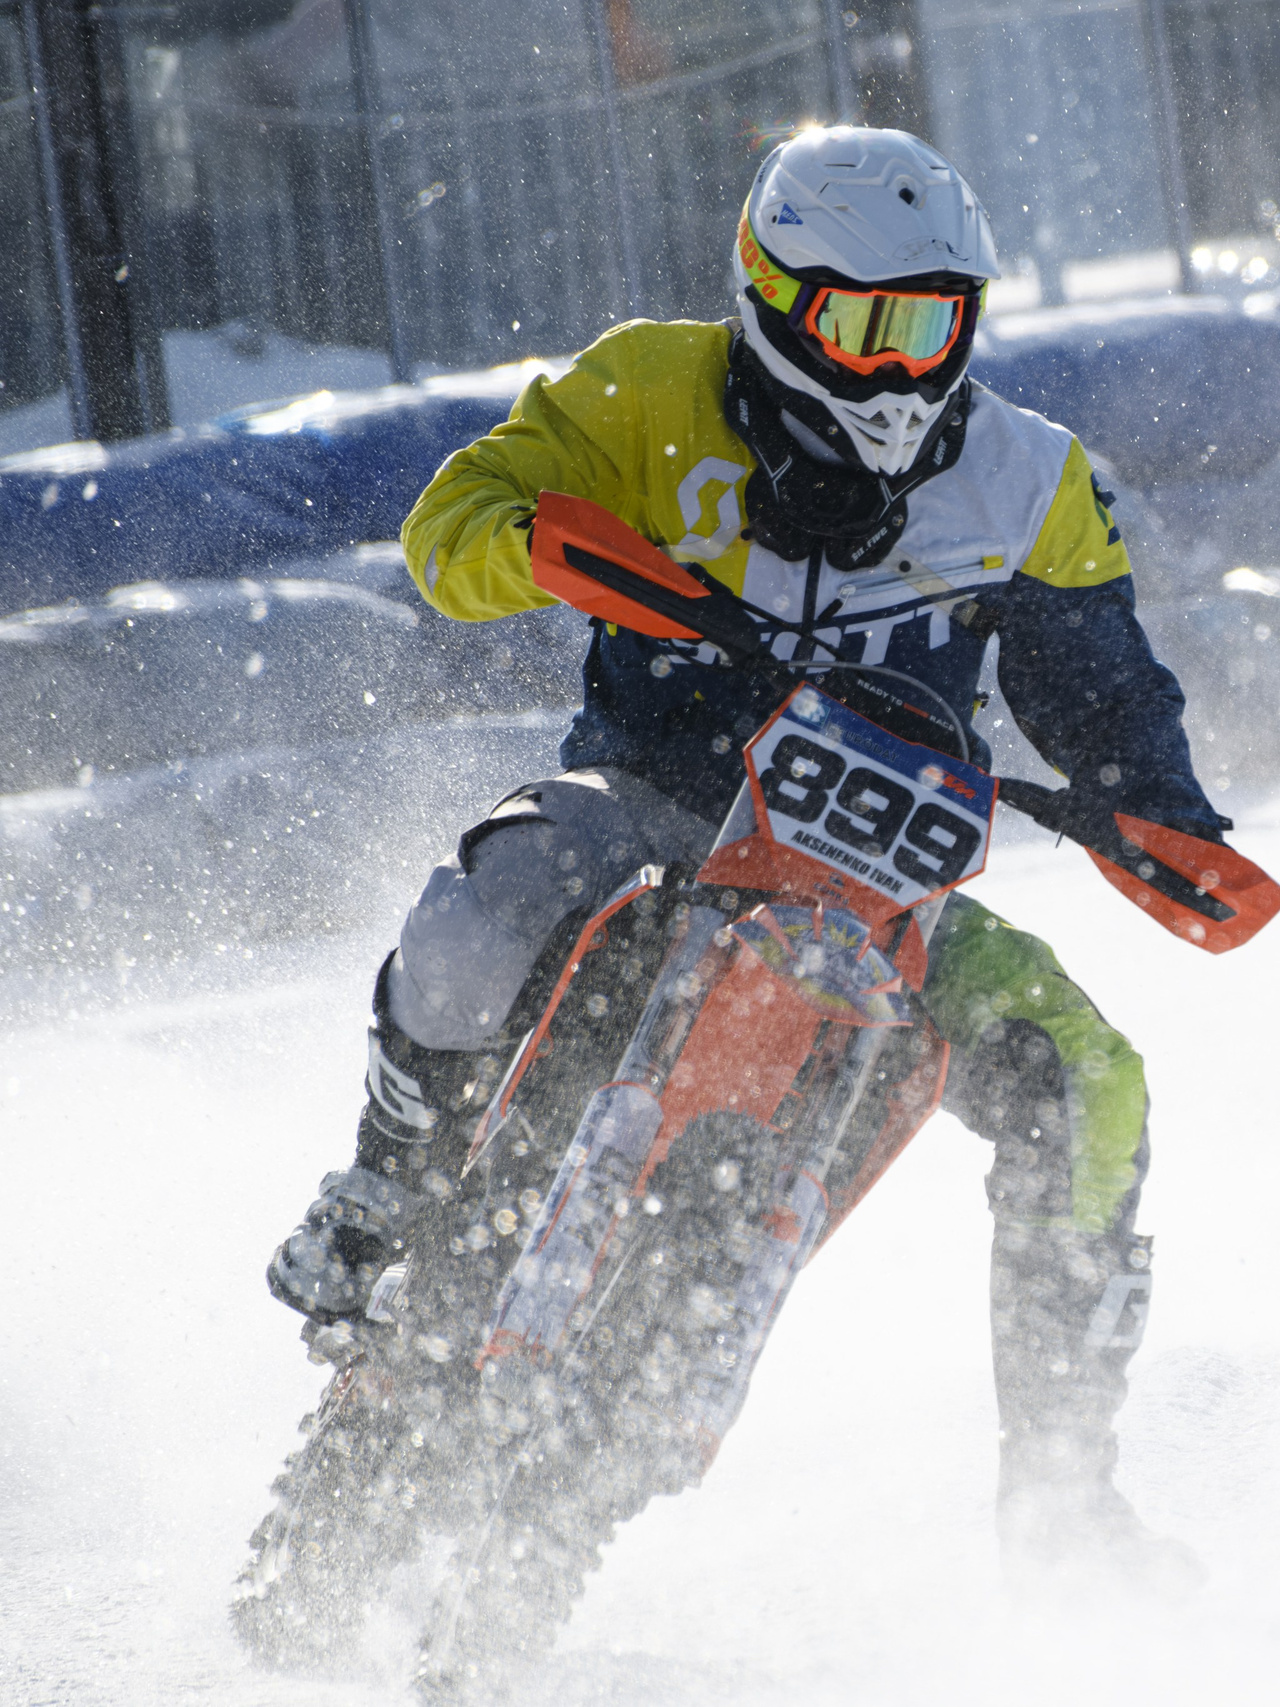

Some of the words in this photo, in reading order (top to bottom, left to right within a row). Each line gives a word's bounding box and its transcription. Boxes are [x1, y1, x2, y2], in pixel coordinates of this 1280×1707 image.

[738, 208, 783, 299] 00%
[857, 679, 889, 699] READY
[890, 695, 903, 706] TO
[929, 715, 955, 731] RACE
[760, 734, 982, 887] 899
[791, 830, 872, 875] AKSENENKO
[869, 868, 904, 894] IVAN
